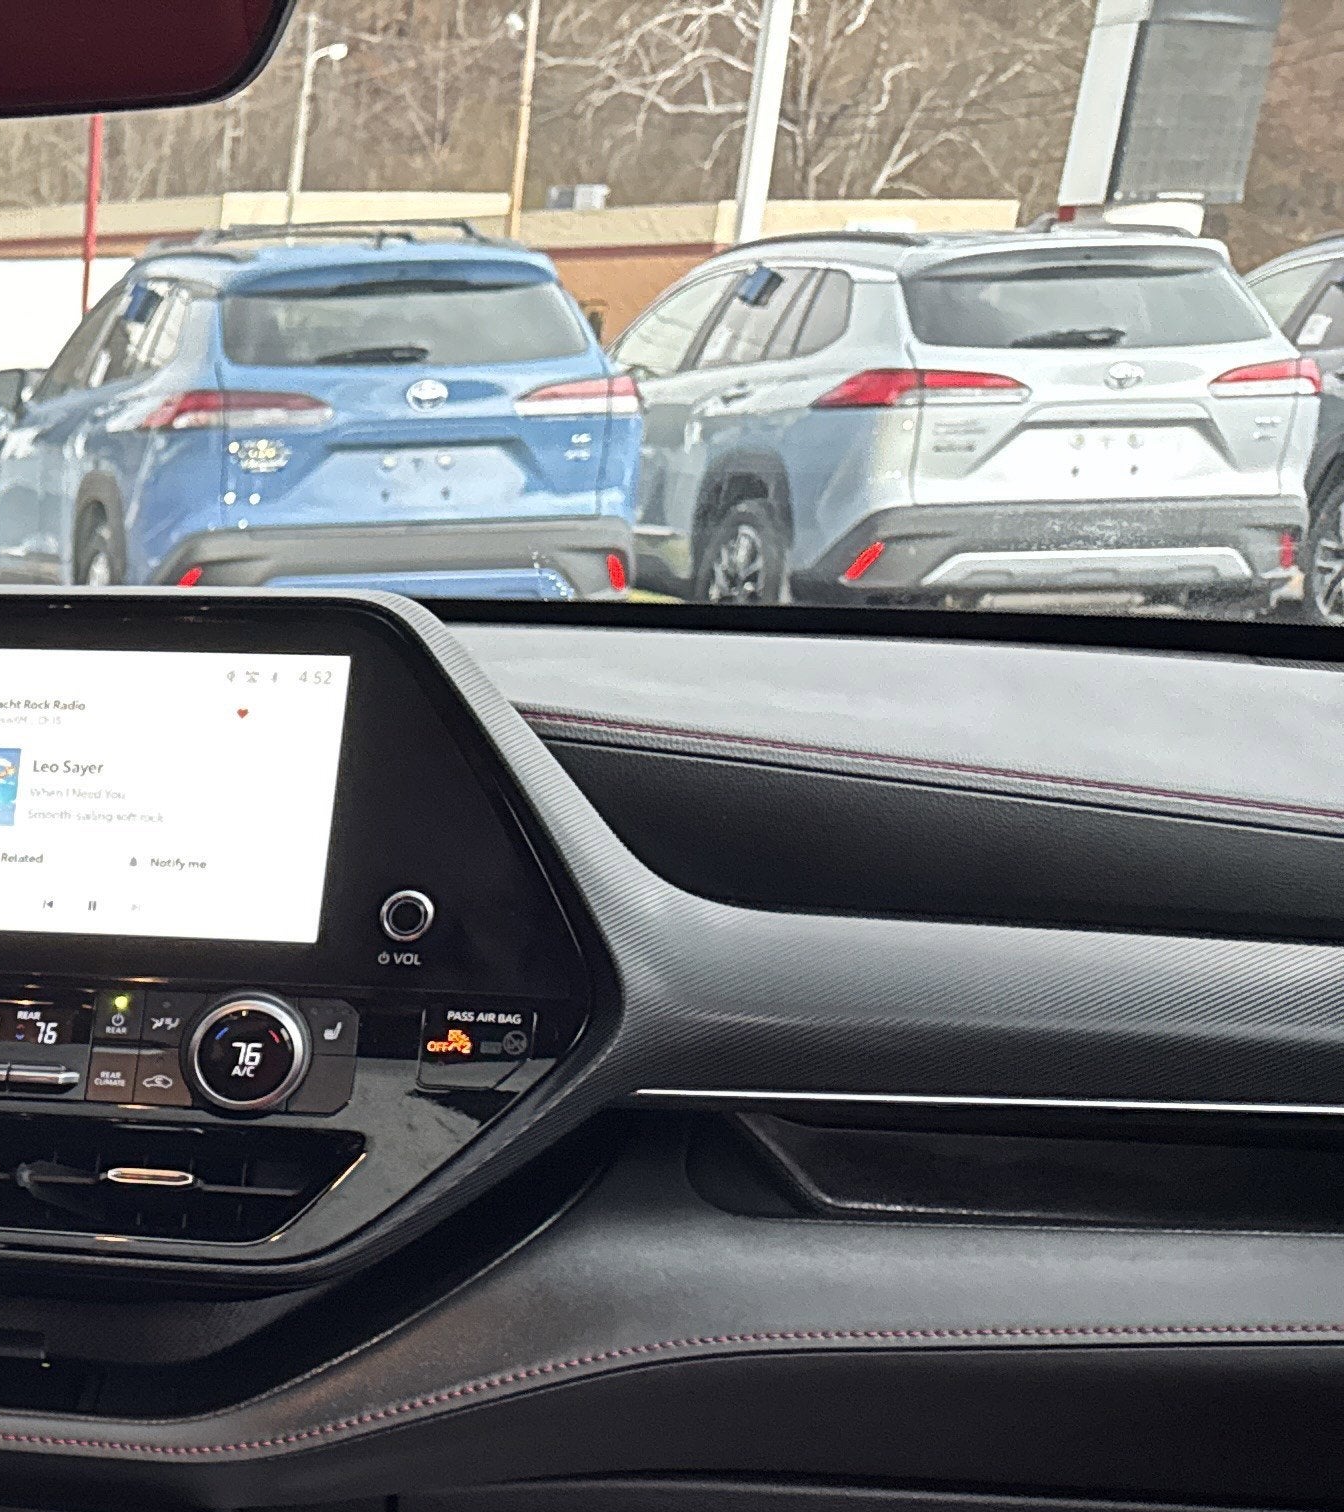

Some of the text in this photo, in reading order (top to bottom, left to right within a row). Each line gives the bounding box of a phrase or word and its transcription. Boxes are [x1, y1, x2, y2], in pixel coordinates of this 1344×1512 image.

[23, 700, 50, 710] Rock
[52, 700, 86, 711] Radio
[32, 760, 105, 777] Leo Sayer
[0, 852, 44, 864] Related
[150, 857, 207, 871] Notify me
[394, 952, 422, 966] VOL
[17, 1011, 41, 1021] REAR
[446, 1011, 523, 1026] PASS AIR BAG
[36, 1021, 59, 1045] 76
[105, 1025, 128, 1036] REAR
[427, 1040, 450, 1053] OFF
[231, 1042, 263, 1066] 76
[100, 1071, 122, 1080] REAR
[231, 1065, 255, 1078] A/C
[94, 1078, 127, 1088] CLIMATE
